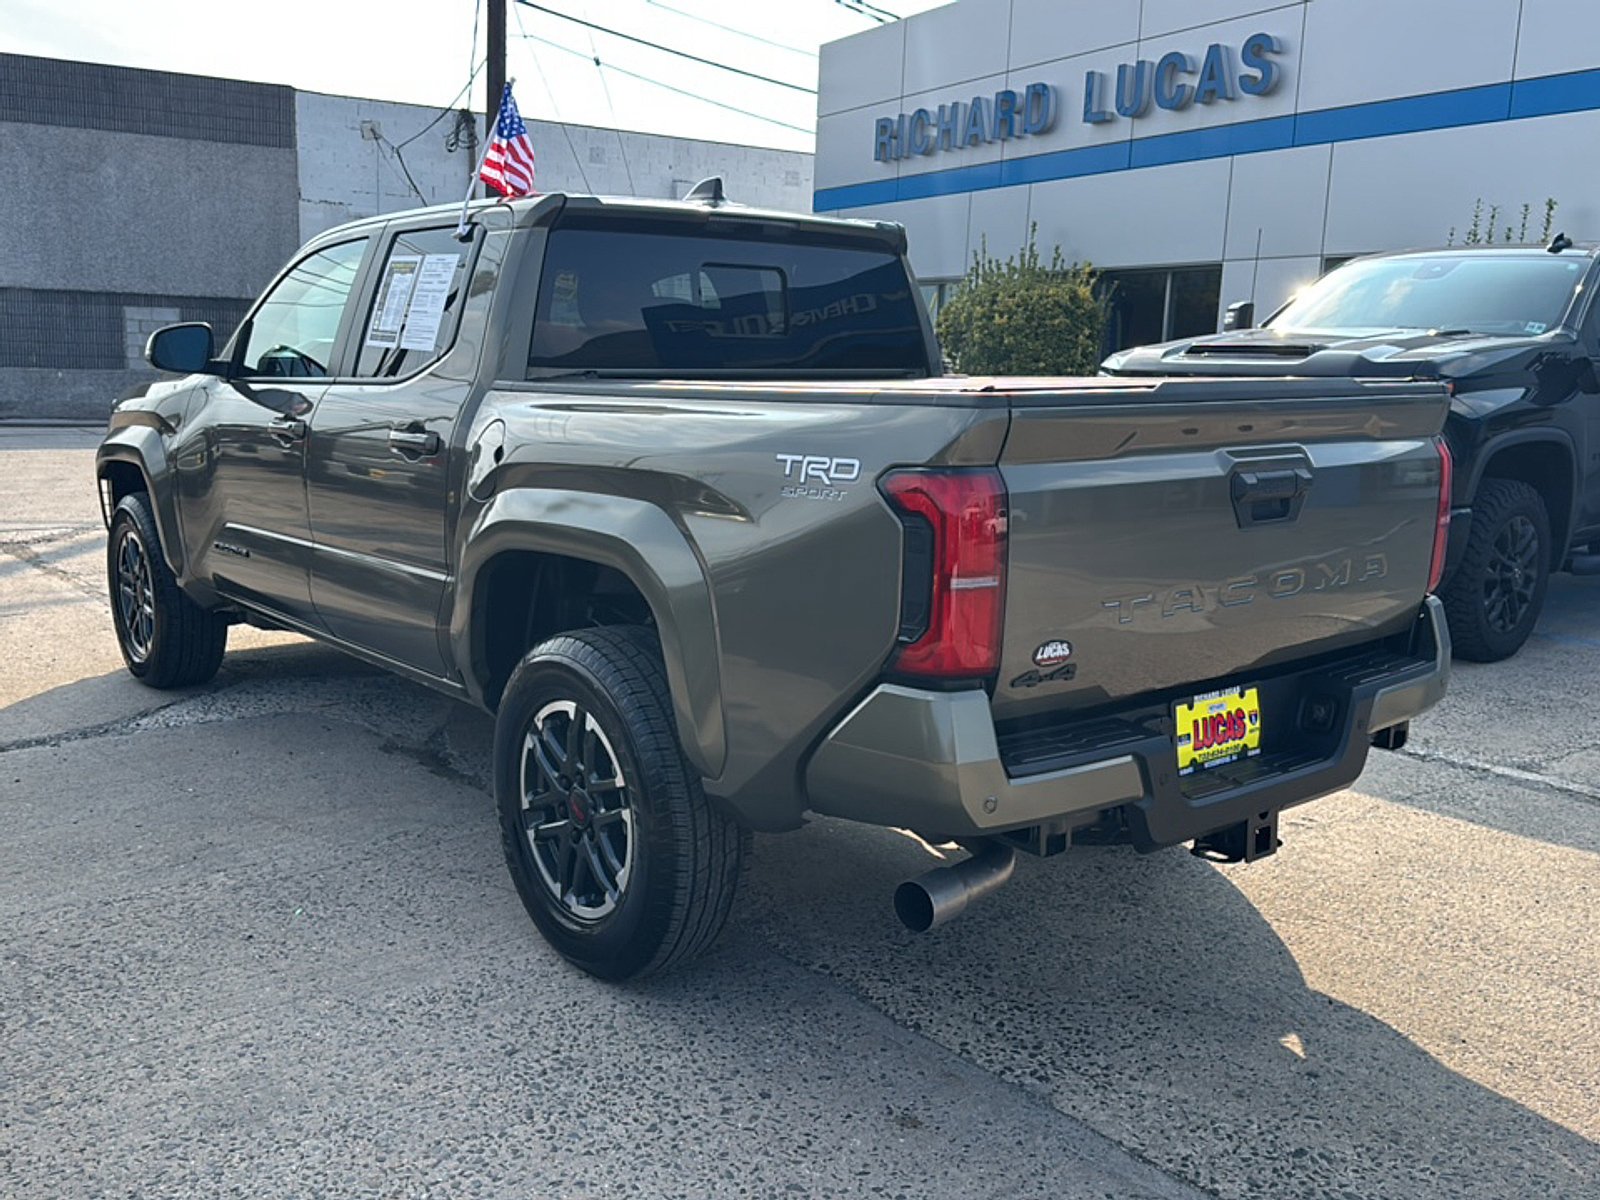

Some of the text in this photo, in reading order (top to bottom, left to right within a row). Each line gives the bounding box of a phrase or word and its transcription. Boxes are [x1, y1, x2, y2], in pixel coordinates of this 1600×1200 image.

[874, 32, 1283, 163] RICHARD LUCAS
[776, 454, 860, 485] TRD
[781, 486, 848, 501] SPORT
[1101, 553, 1388, 624] TACOMA
[1036, 641, 1070, 660] LUCAS
[1193, 708, 1246, 751] LUCAS
